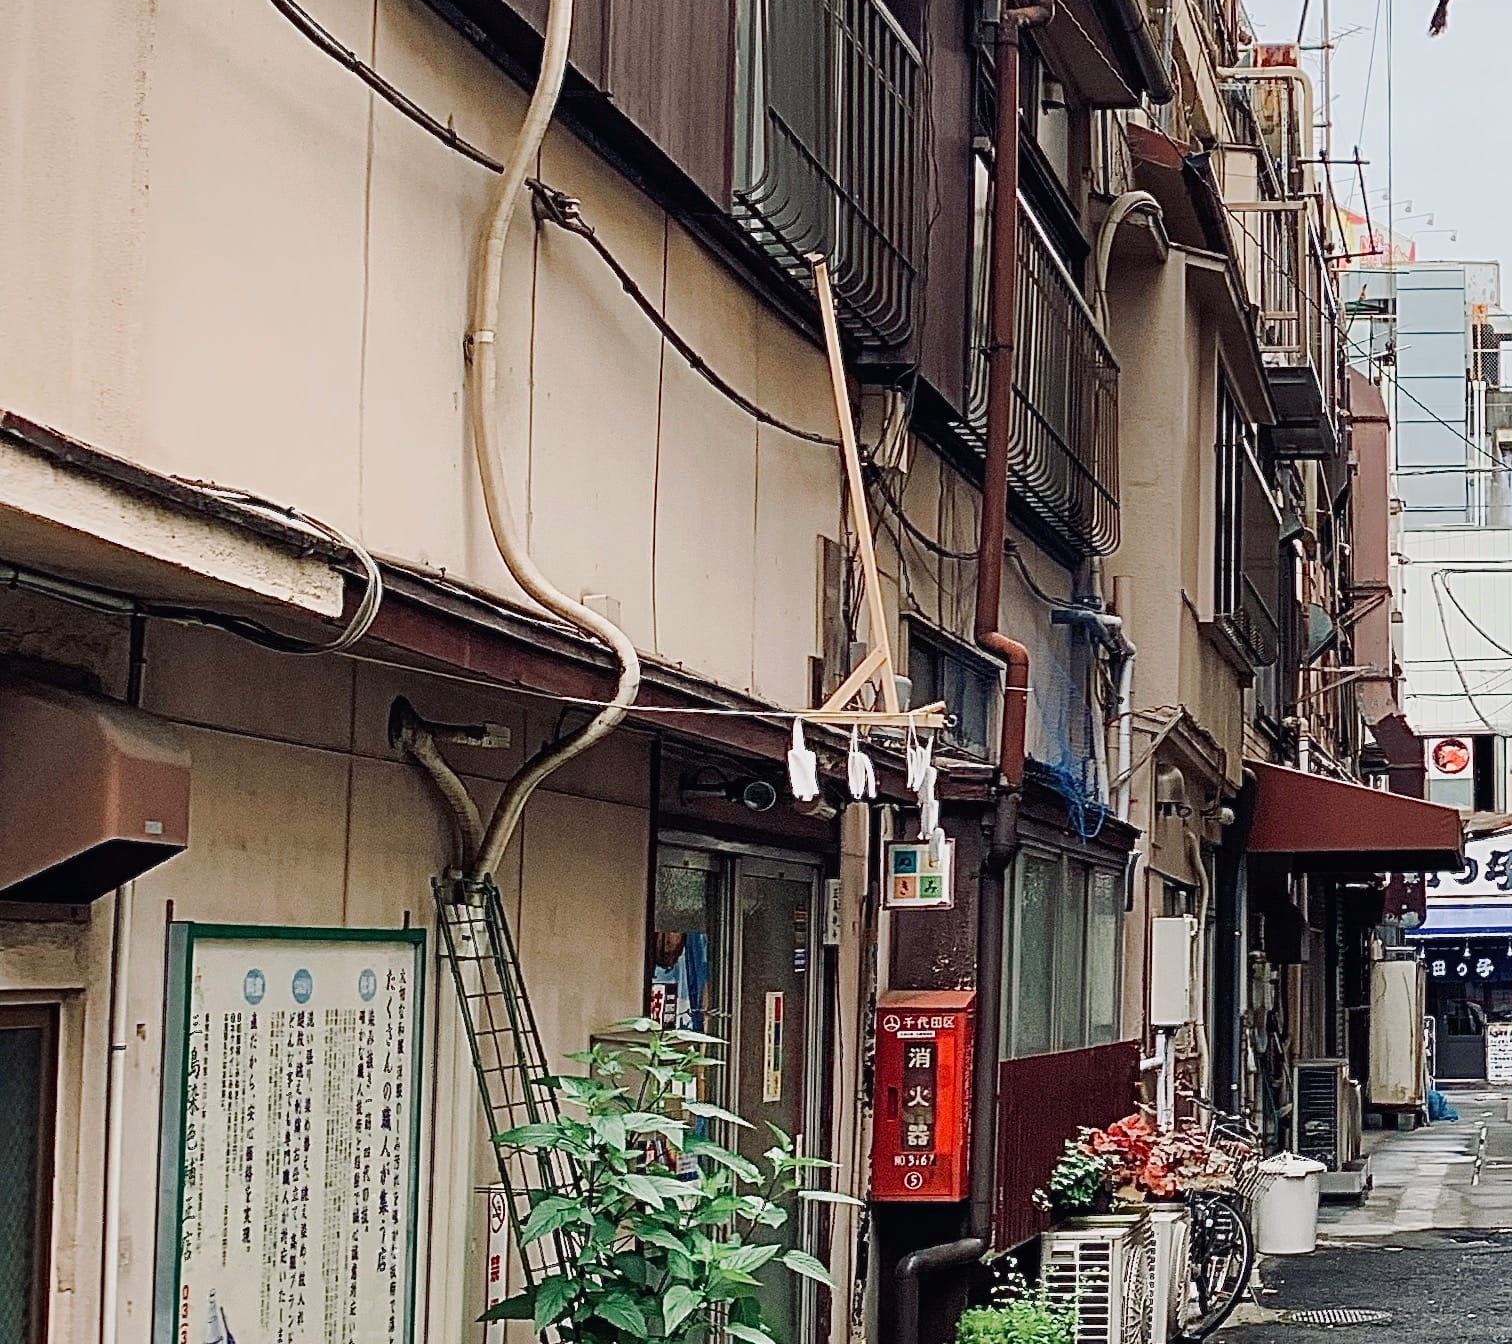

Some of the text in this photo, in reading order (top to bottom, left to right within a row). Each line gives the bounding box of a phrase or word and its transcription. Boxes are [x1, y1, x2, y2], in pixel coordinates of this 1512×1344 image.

[902, 1016, 956, 1030] 千代田区
[907, 1047, 932, 1147] 消火器
